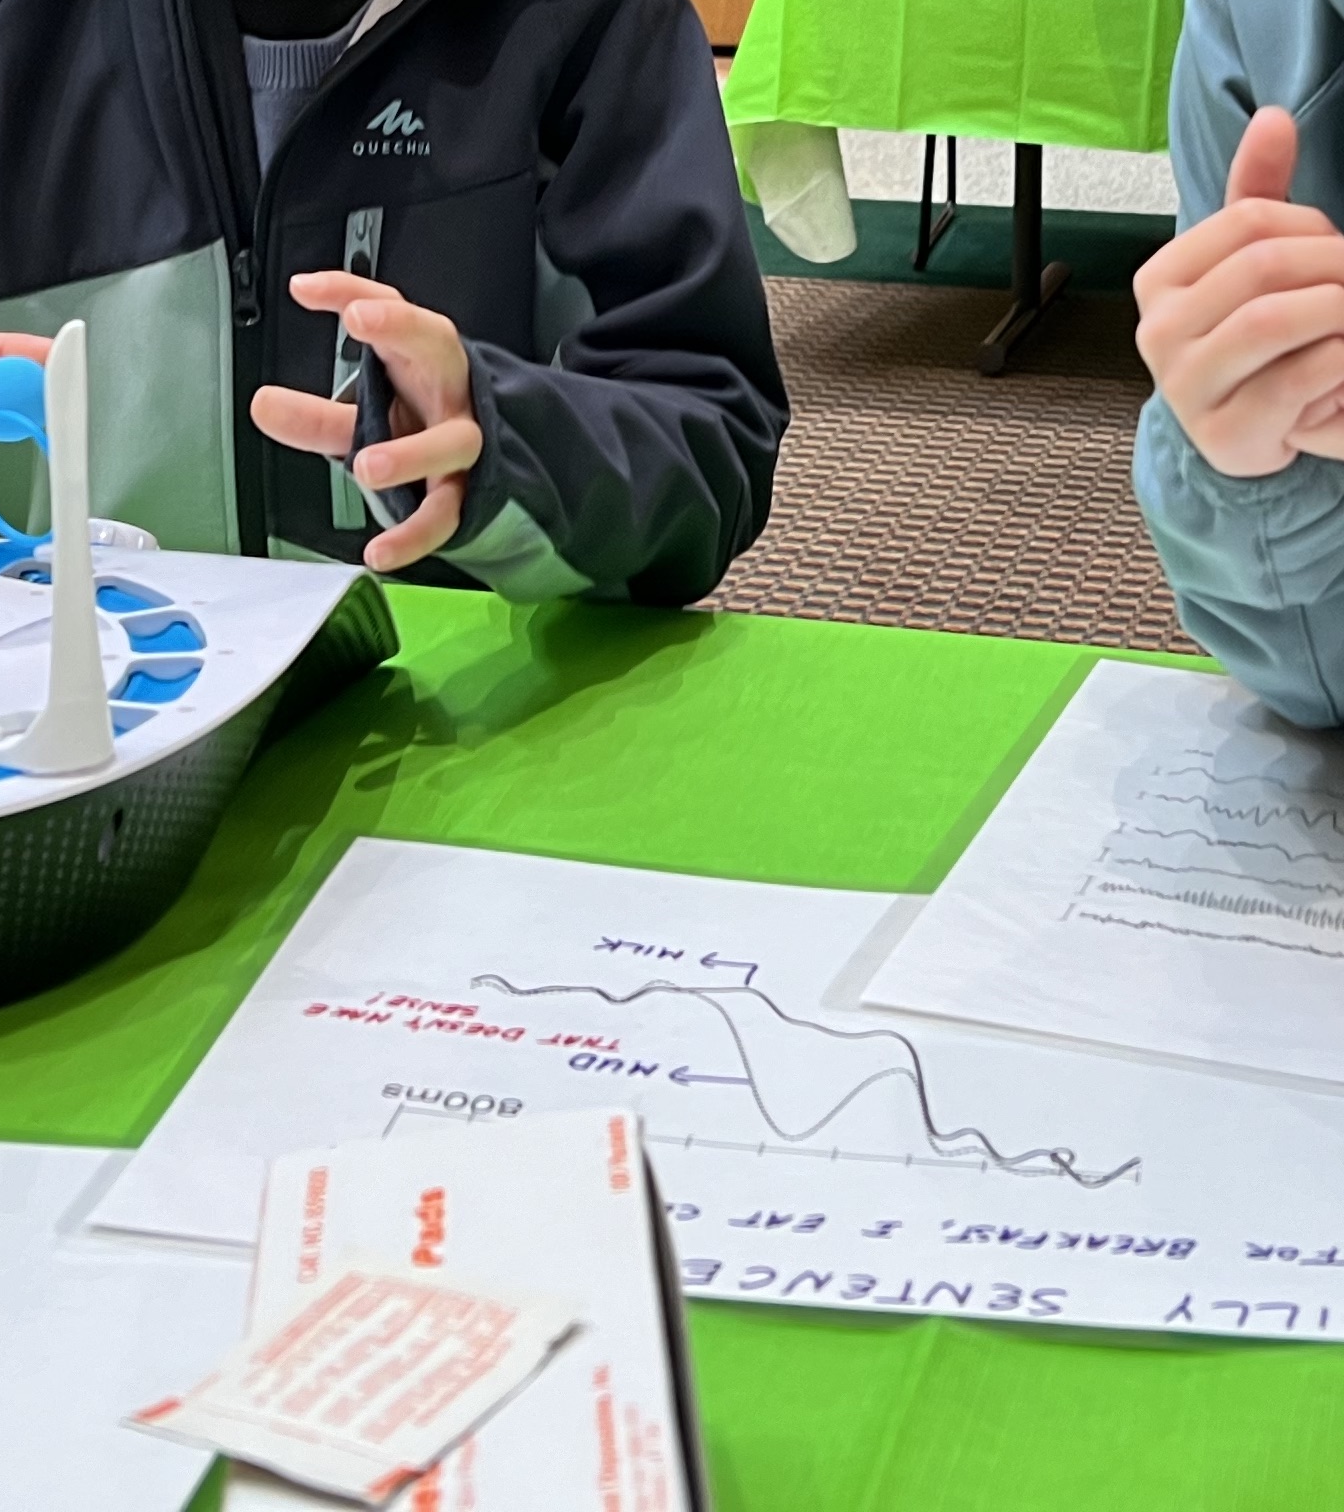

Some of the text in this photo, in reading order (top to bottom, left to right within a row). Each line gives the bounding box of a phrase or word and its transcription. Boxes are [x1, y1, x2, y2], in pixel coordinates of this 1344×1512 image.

[594, 936, 685, 962] MILK
[536, 1033, 621, 1053] THAT
[568, 1052, 658, 1078] MUD
[412, 1187, 446, 1267] Pads
[727, 1210, 826, 1234] EAT
[940, 1218, 1197, 1261] BREAKFAST,
[681, 1259, 1067, 1317] SENTENCE
